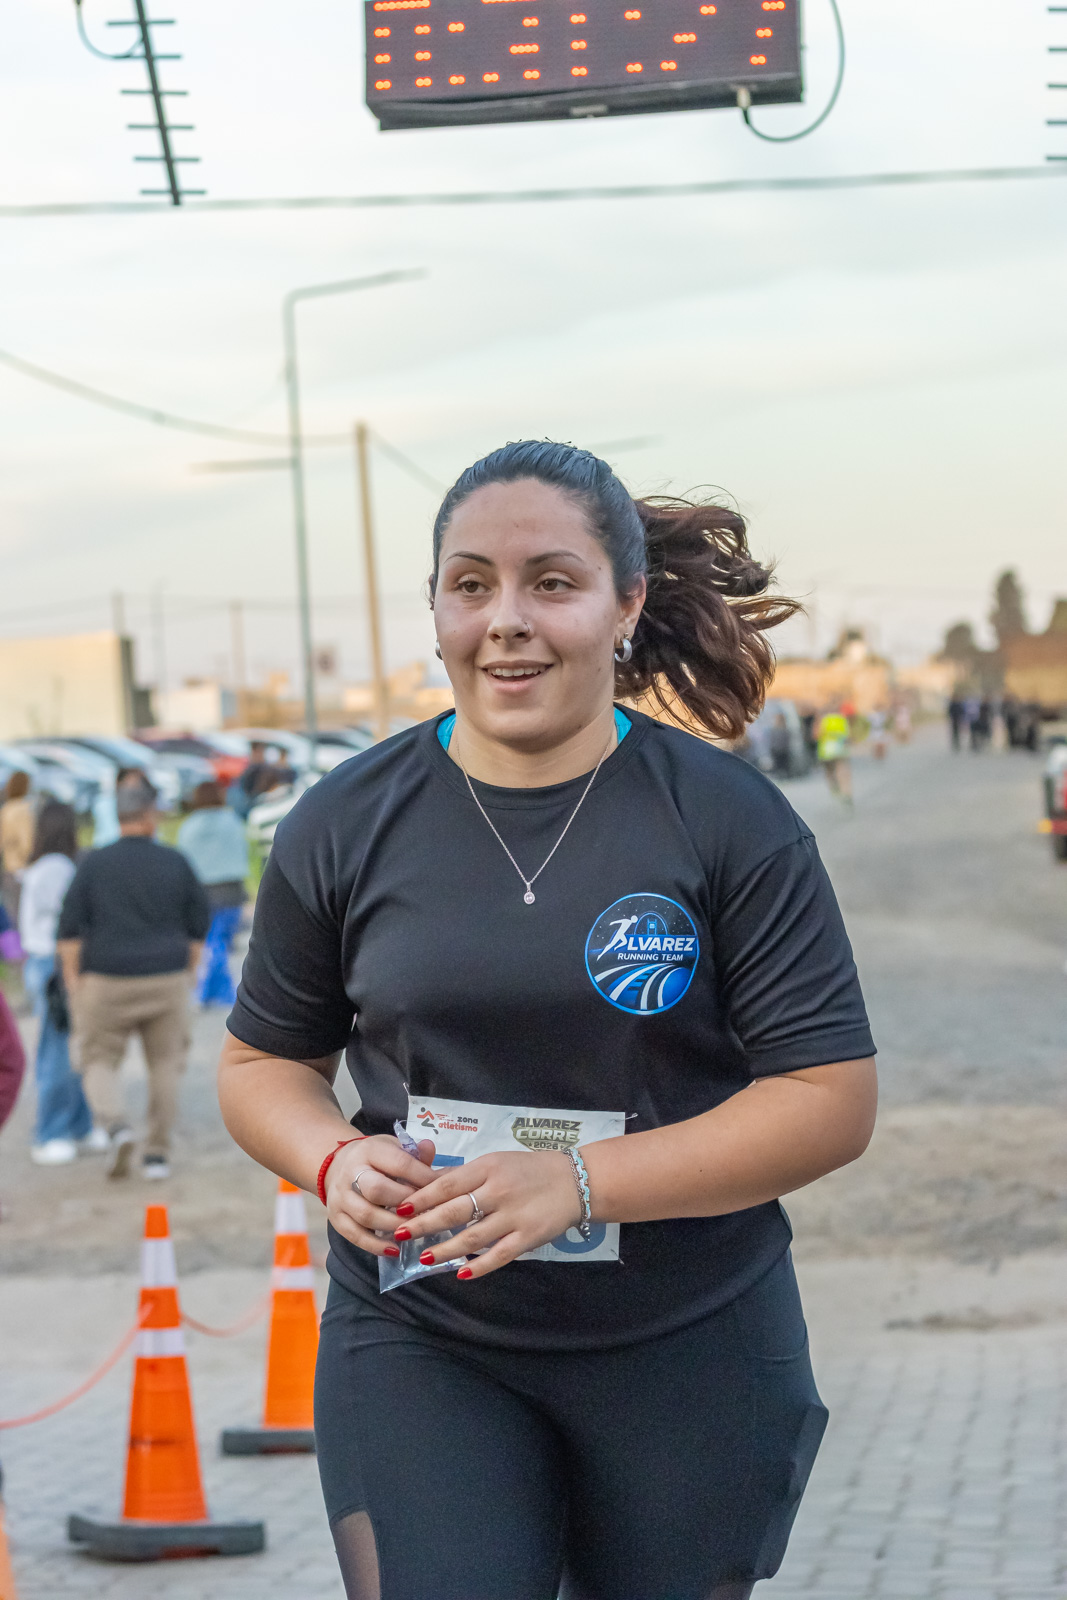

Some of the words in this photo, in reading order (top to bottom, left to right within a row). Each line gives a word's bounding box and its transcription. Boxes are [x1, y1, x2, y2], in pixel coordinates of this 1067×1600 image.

[617, 952, 659, 961] RUNNING
[661, 953, 683, 961] TEAM
[457, 1116, 479, 1124] zona
[513, 1117, 581, 1130] ALVAREZ
[438, 1121, 478, 1132] atletismo
[515, 1128, 578, 1143] CORRE
[533, 1141, 559, 1150] 2026
